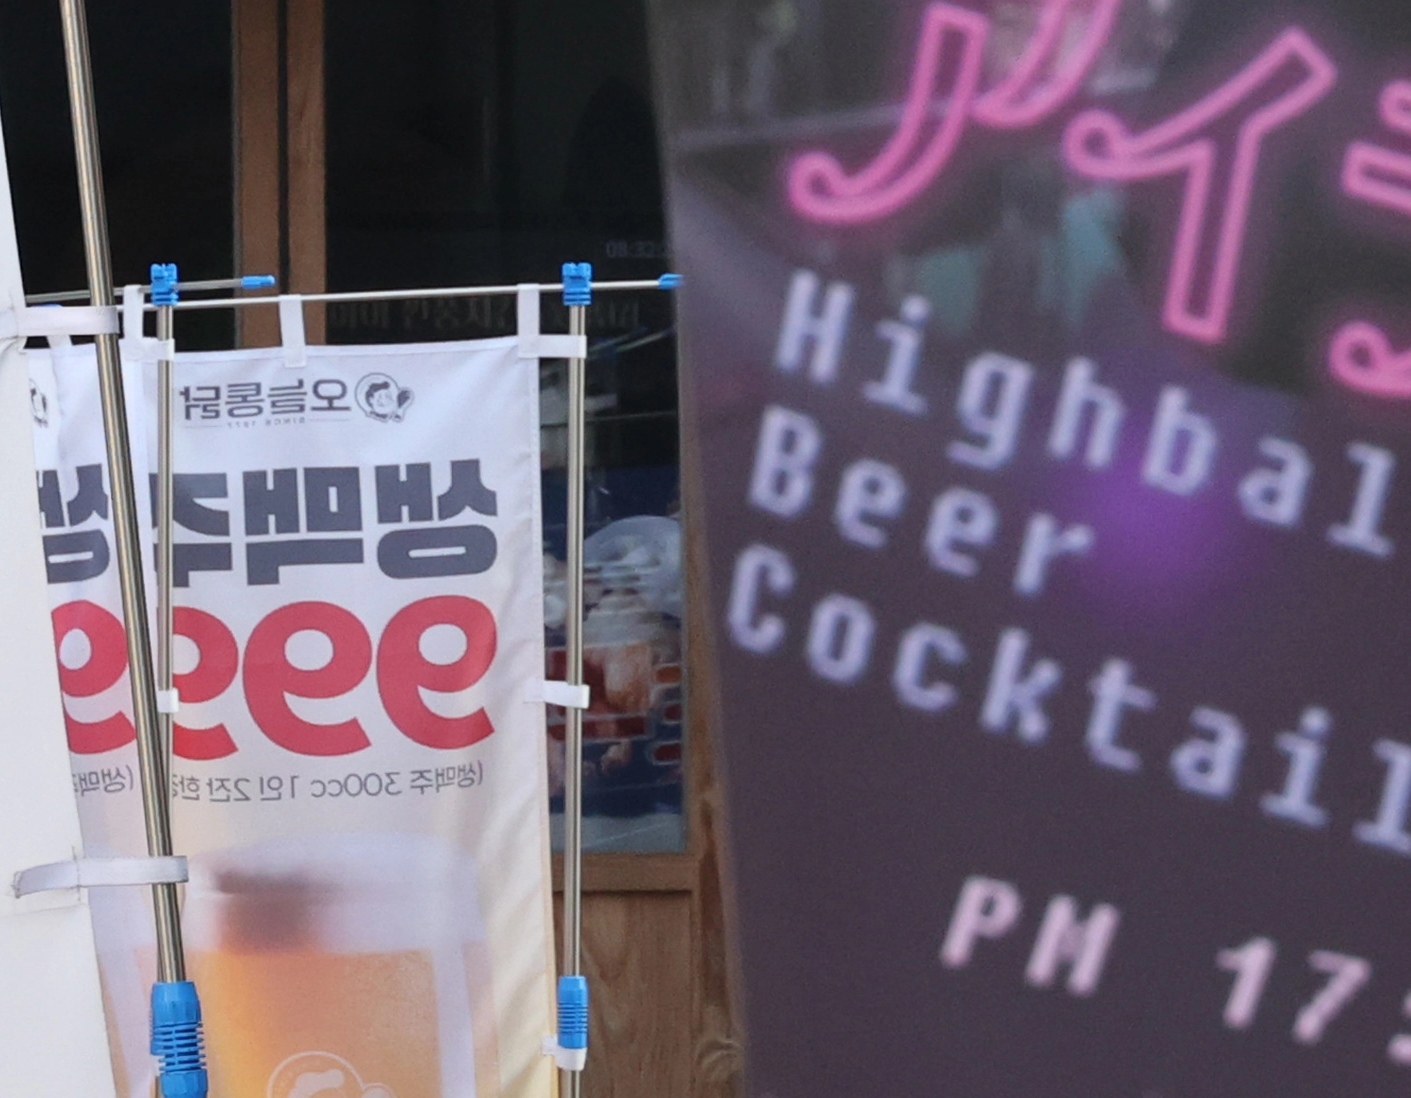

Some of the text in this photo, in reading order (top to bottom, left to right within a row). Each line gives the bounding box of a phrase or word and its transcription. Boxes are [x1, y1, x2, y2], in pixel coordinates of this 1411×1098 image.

[747, 404, 1096, 597] Beer
[726, 543, 1411, 853] Cocktail
[940, 873, 1121, 997] PM
